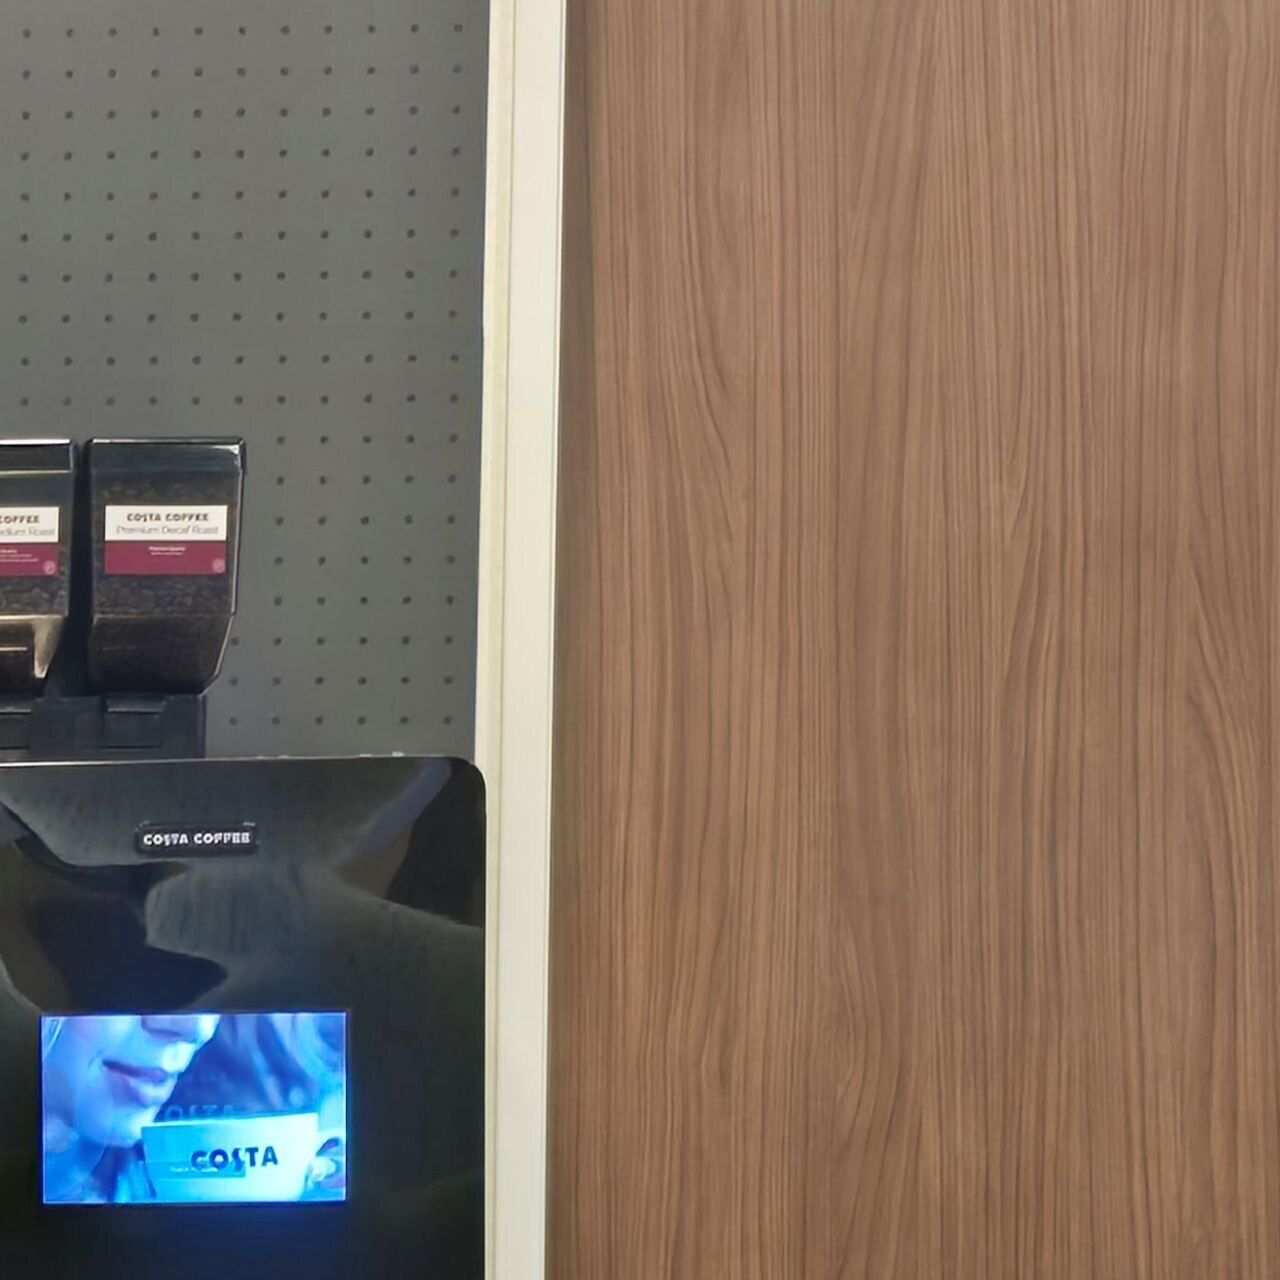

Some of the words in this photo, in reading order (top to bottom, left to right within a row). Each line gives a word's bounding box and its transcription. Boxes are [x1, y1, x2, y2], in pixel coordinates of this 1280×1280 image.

[143, 833, 189, 846] COSTA
[193, 832, 251, 844] COFFEE
[191, 1145, 279, 1172] COSTA
